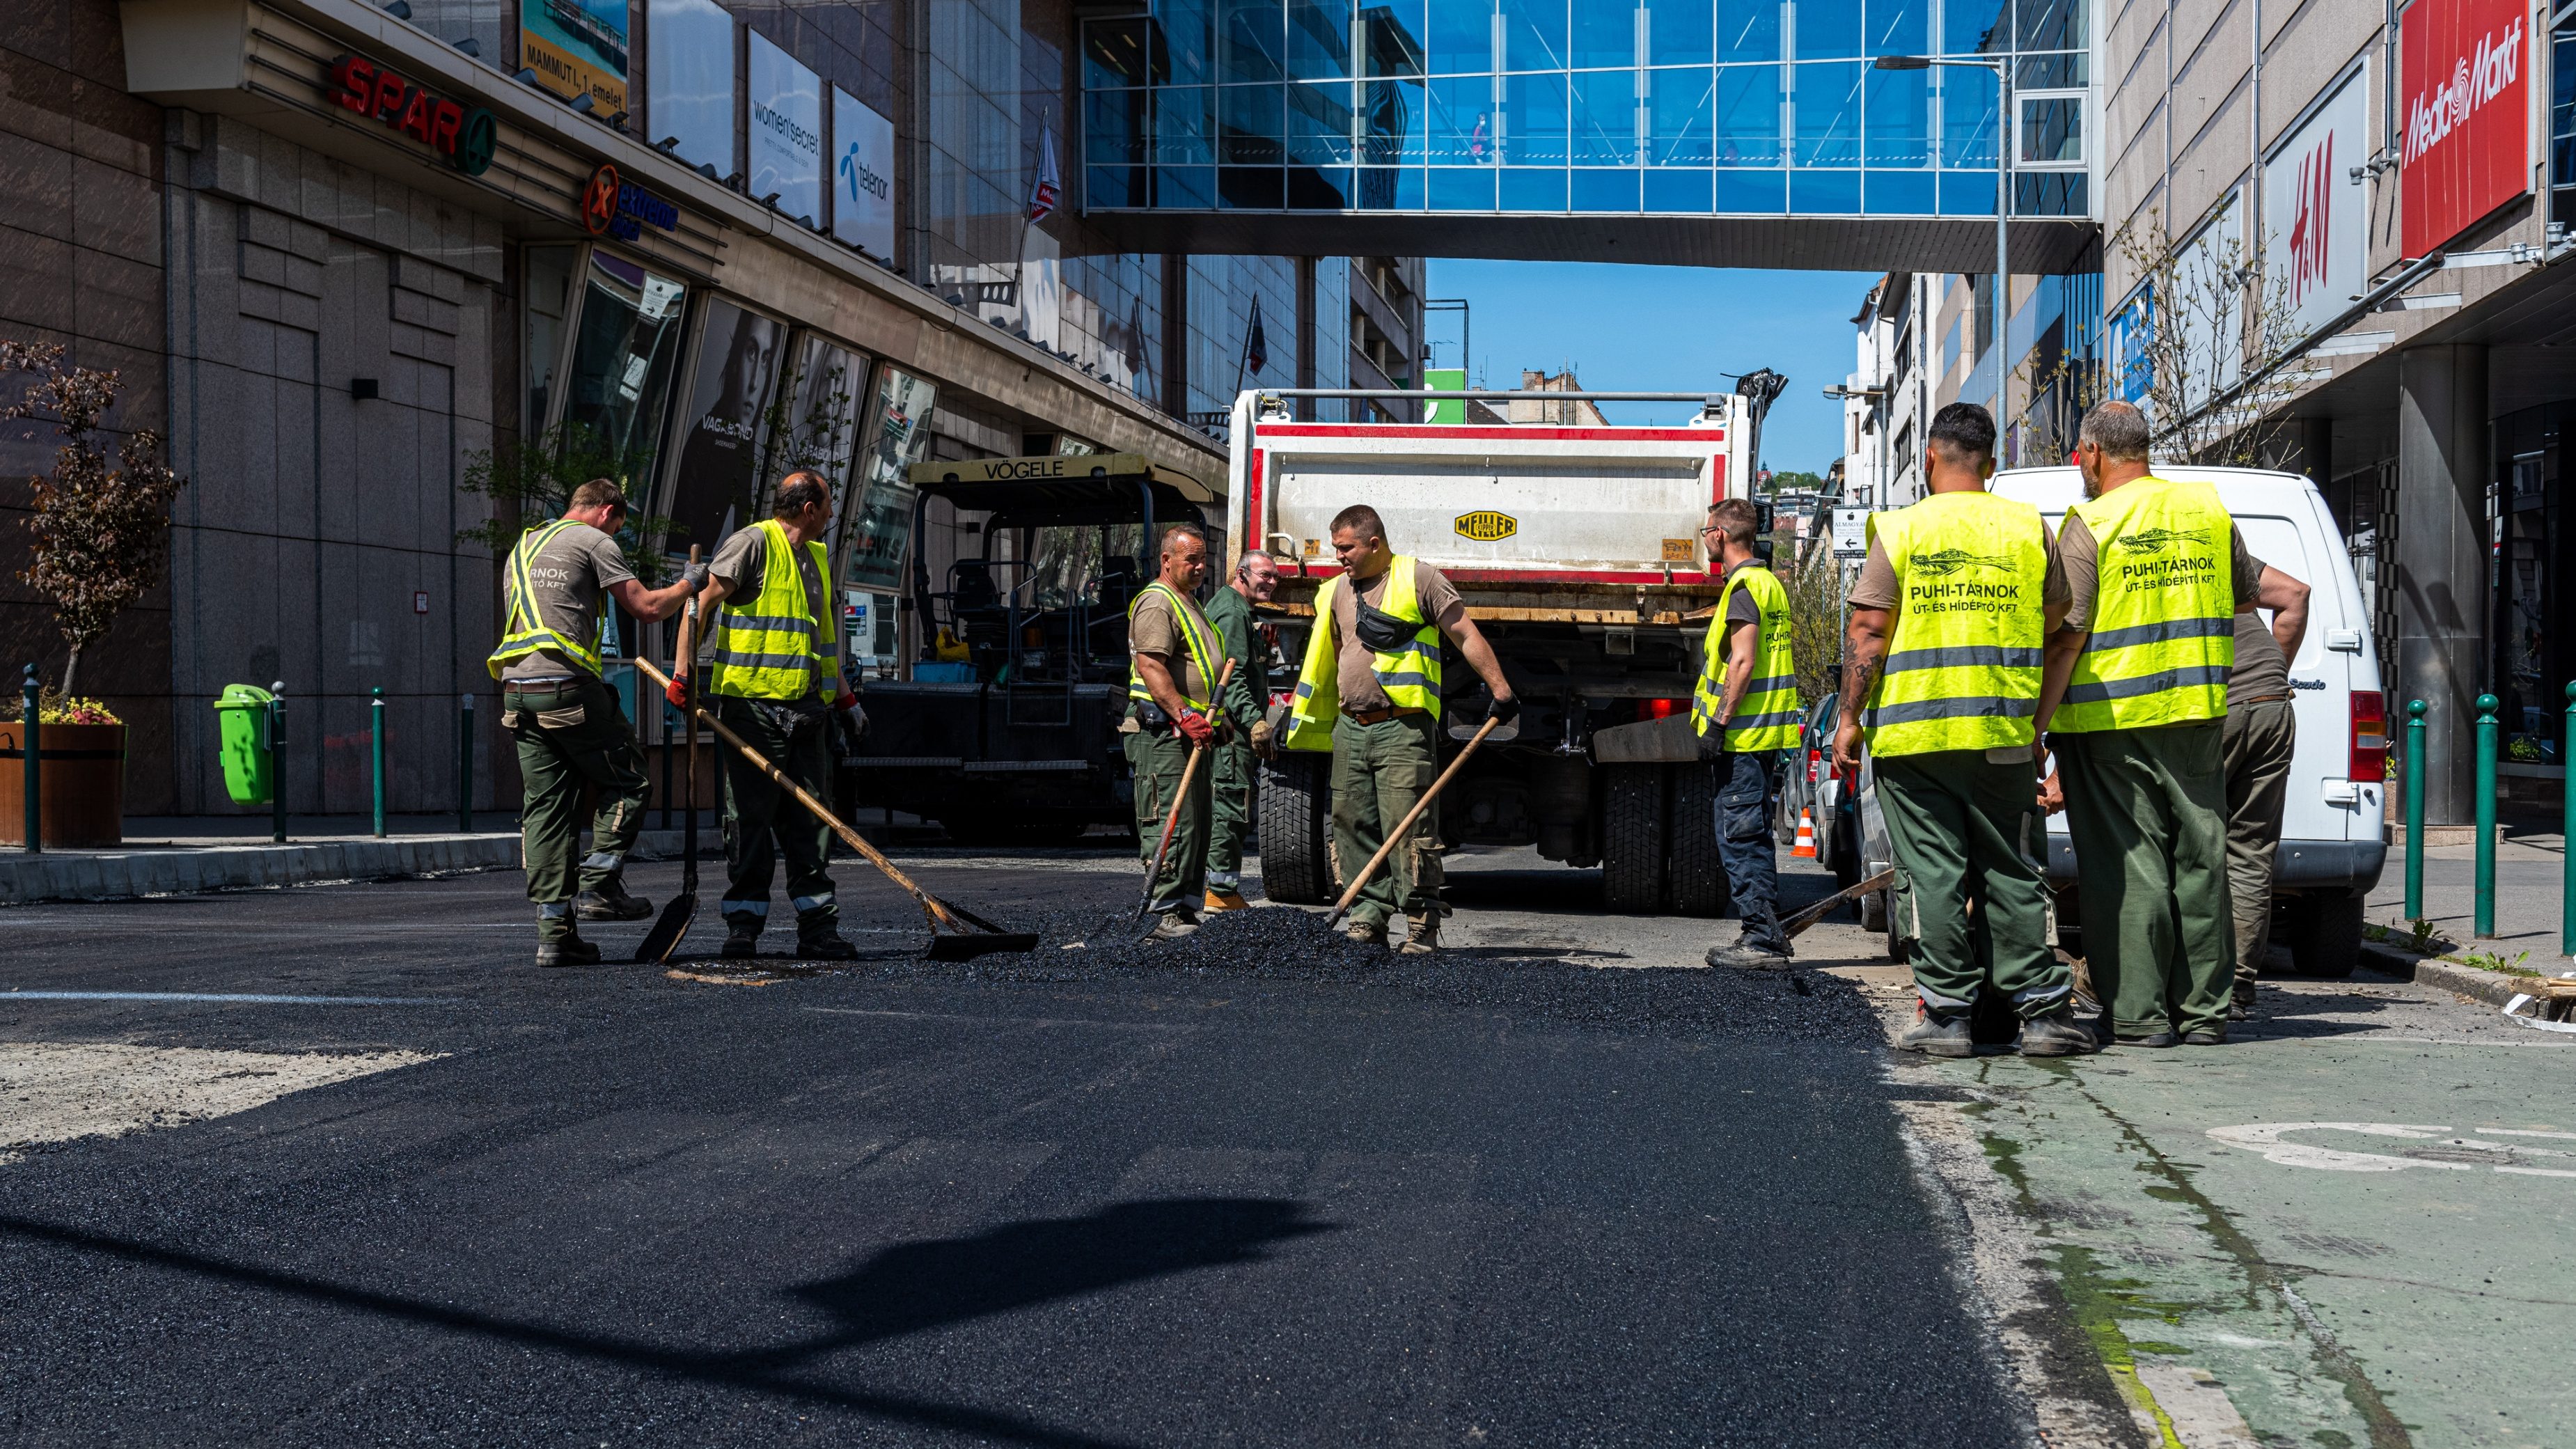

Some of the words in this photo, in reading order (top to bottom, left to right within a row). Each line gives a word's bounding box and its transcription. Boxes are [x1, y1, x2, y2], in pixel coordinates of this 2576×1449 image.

[527, 44, 572, 84] MAMMUT
[592, 83, 622, 110] emelet
[342, 56, 462, 155] SPAR
[754, 100, 819, 156] women'secret
[858, 162, 888, 201] telenor
[2290, 128, 2333, 308] H&M
[984, 460, 1064, 480] VÖGELE
[1458, 514, 1514, 538] MEILLER
[2123, 556, 2215, 579] PUHI-TÁRNOK
[547, 581, 566, 590] KFT
[1910, 579, 2019, 600] PUHI-TÁRNOK
[2144, 579, 2156, 590] ÉS
[2201, 574, 2215, 584] KFT
[1932, 601, 1946, 613] ÉS
[1997, 602, 2018, 613] KFT
[2289, 678, 2326, 690] Scudo
